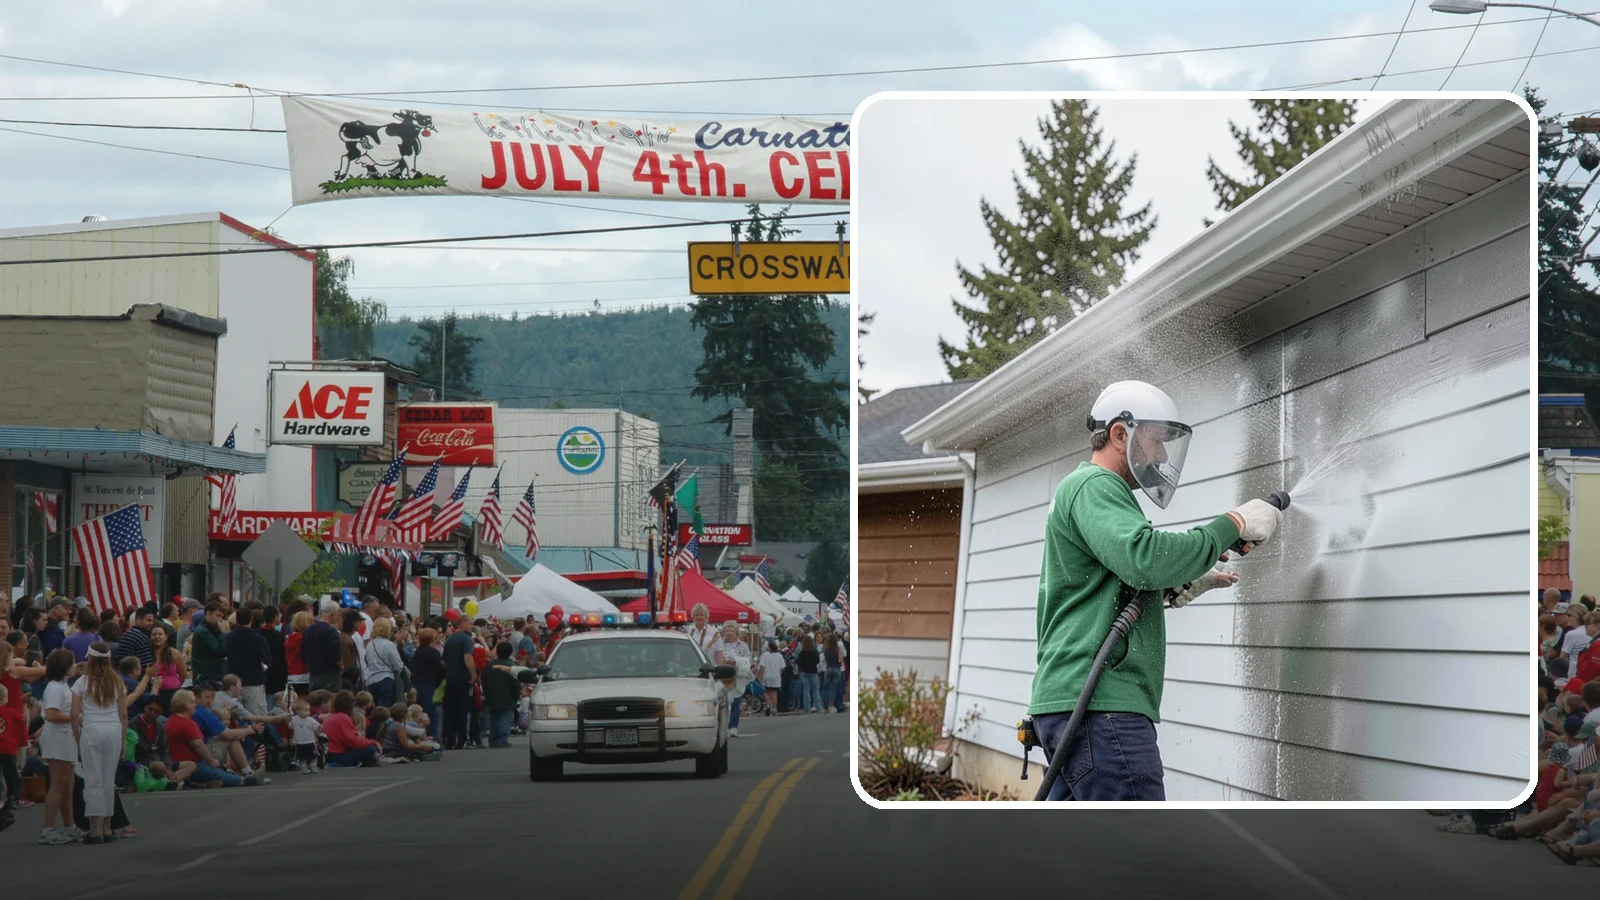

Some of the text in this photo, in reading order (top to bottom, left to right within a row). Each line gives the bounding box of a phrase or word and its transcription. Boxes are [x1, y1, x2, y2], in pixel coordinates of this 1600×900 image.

[481, 141, 605, 192] JULY
[632, 150, 746, 198] 4th.
[697, 254, 850, 280] CROSSWA
[282, 380, 373, 420] ACE
[405, 409, 453, 421] CEDAR
[283, 421, 371, 437] Hardware
[416, 428, 477, 447] Coca-Cola
[353, 467, 384, 480] Simpl
[95, 484, 124, 495] Vincent
[126, 485, 136, 495] de
[138, 486, 155, 495] Paul
[688, 526, 741, 535] CRNATION
